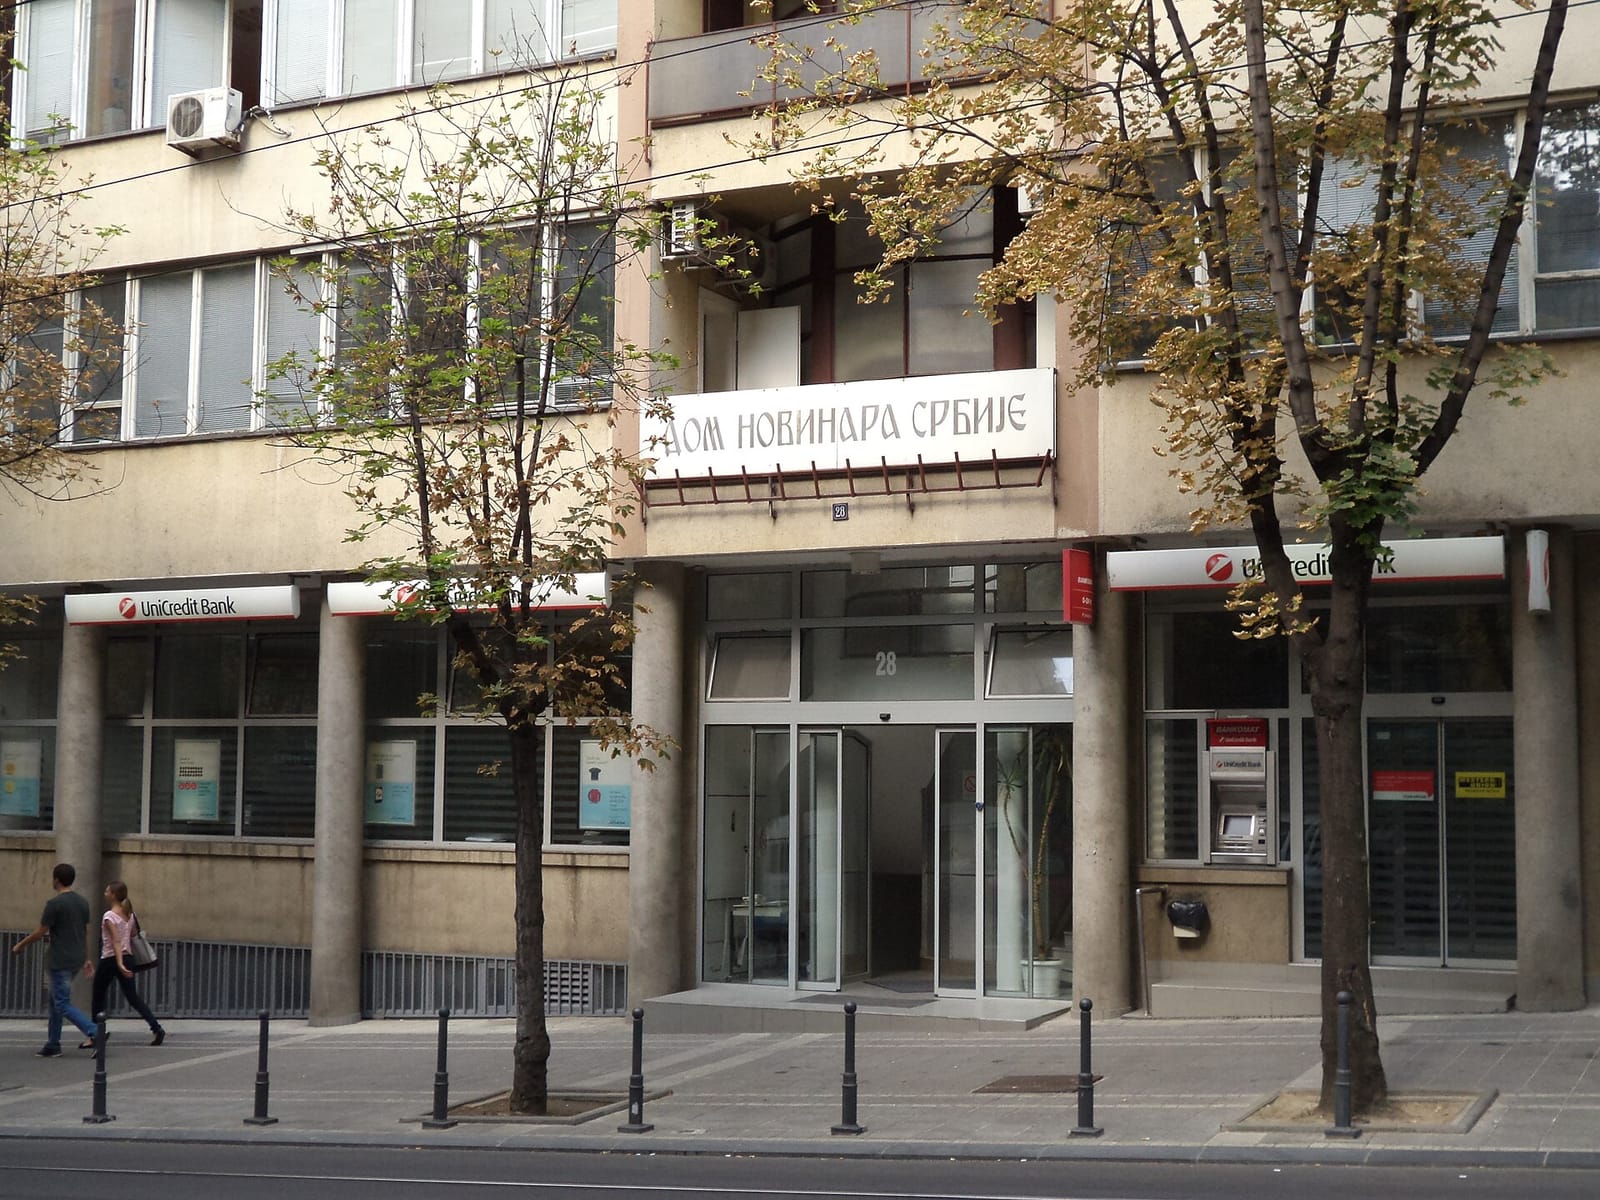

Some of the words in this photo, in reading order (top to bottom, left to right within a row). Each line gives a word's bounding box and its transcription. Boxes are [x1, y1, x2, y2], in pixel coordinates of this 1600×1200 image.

[665, 416, 725, 456] ДОМ
[738, 403, 901, 448] НОВИНАРА
[912, 393, 1027, 437] СРБИЈЕ
[835, 505, 846, 518] 28
[141, 597, 199, 616] UniCredit
[201, 595, 236, 615] Bank
[875, 651, 897, 676] 28
